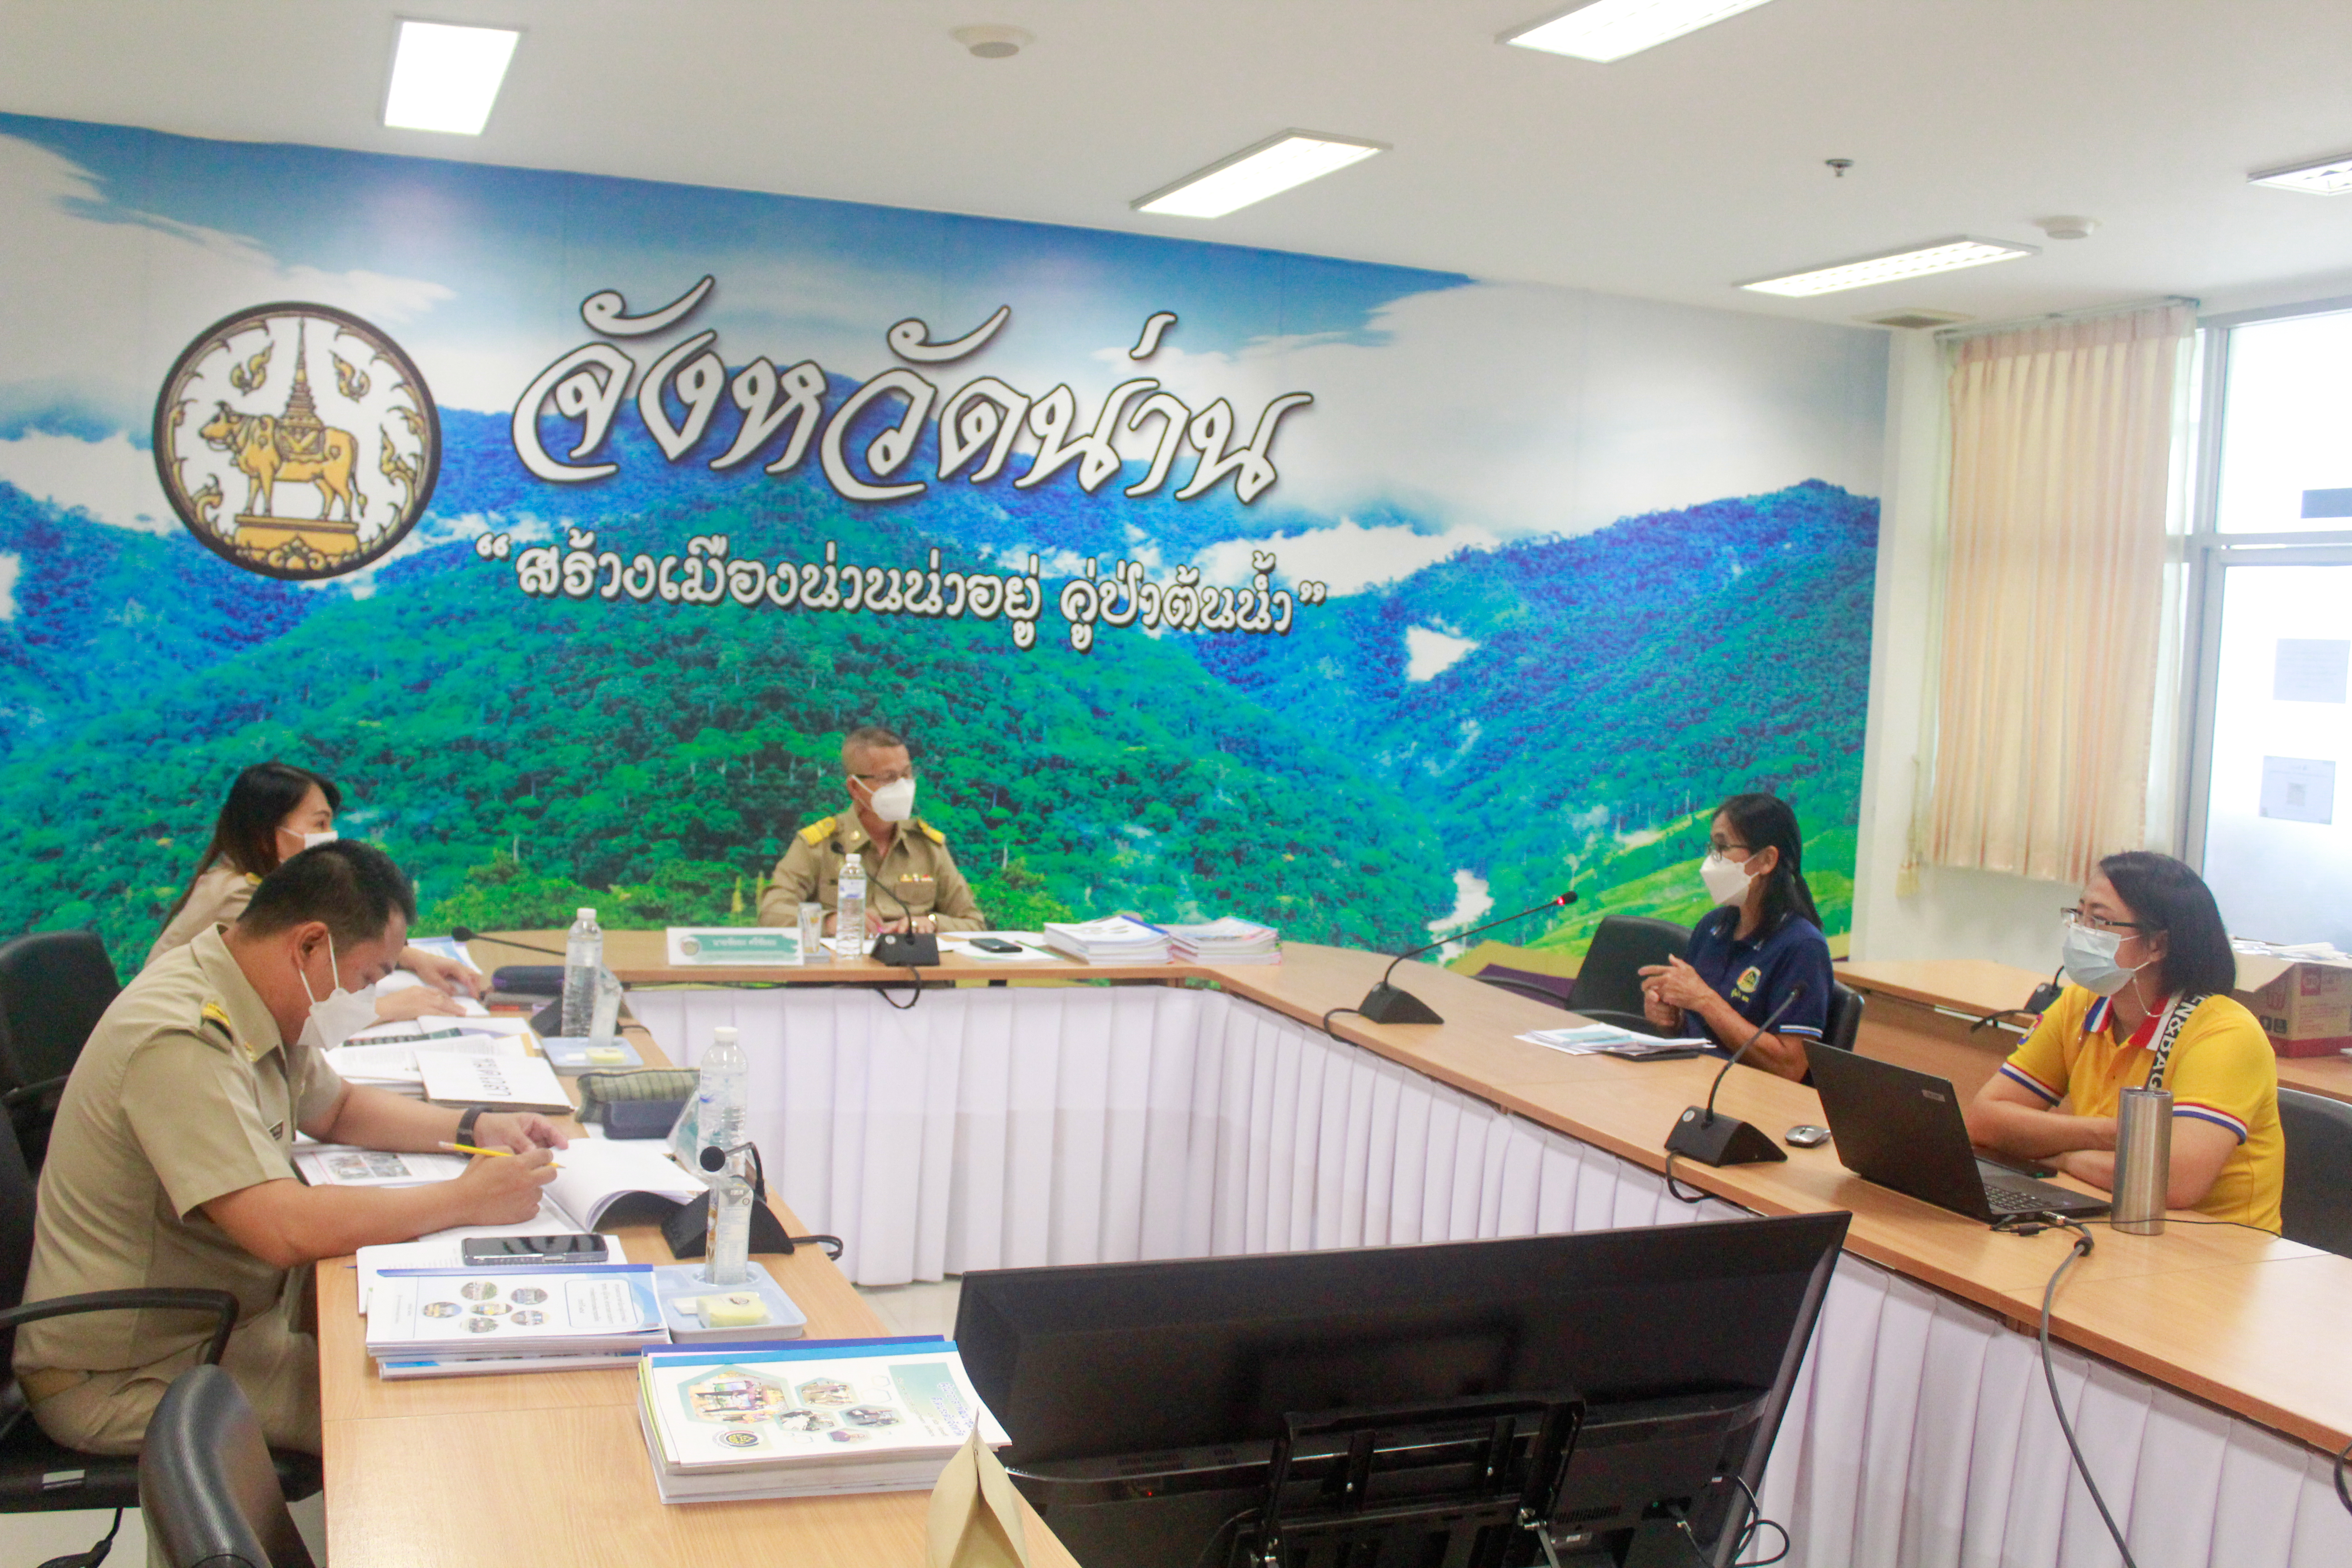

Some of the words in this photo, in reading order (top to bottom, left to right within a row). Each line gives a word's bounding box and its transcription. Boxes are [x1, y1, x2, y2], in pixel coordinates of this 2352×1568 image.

[511, 274, 1314, 504] จังหวัดน่าน
